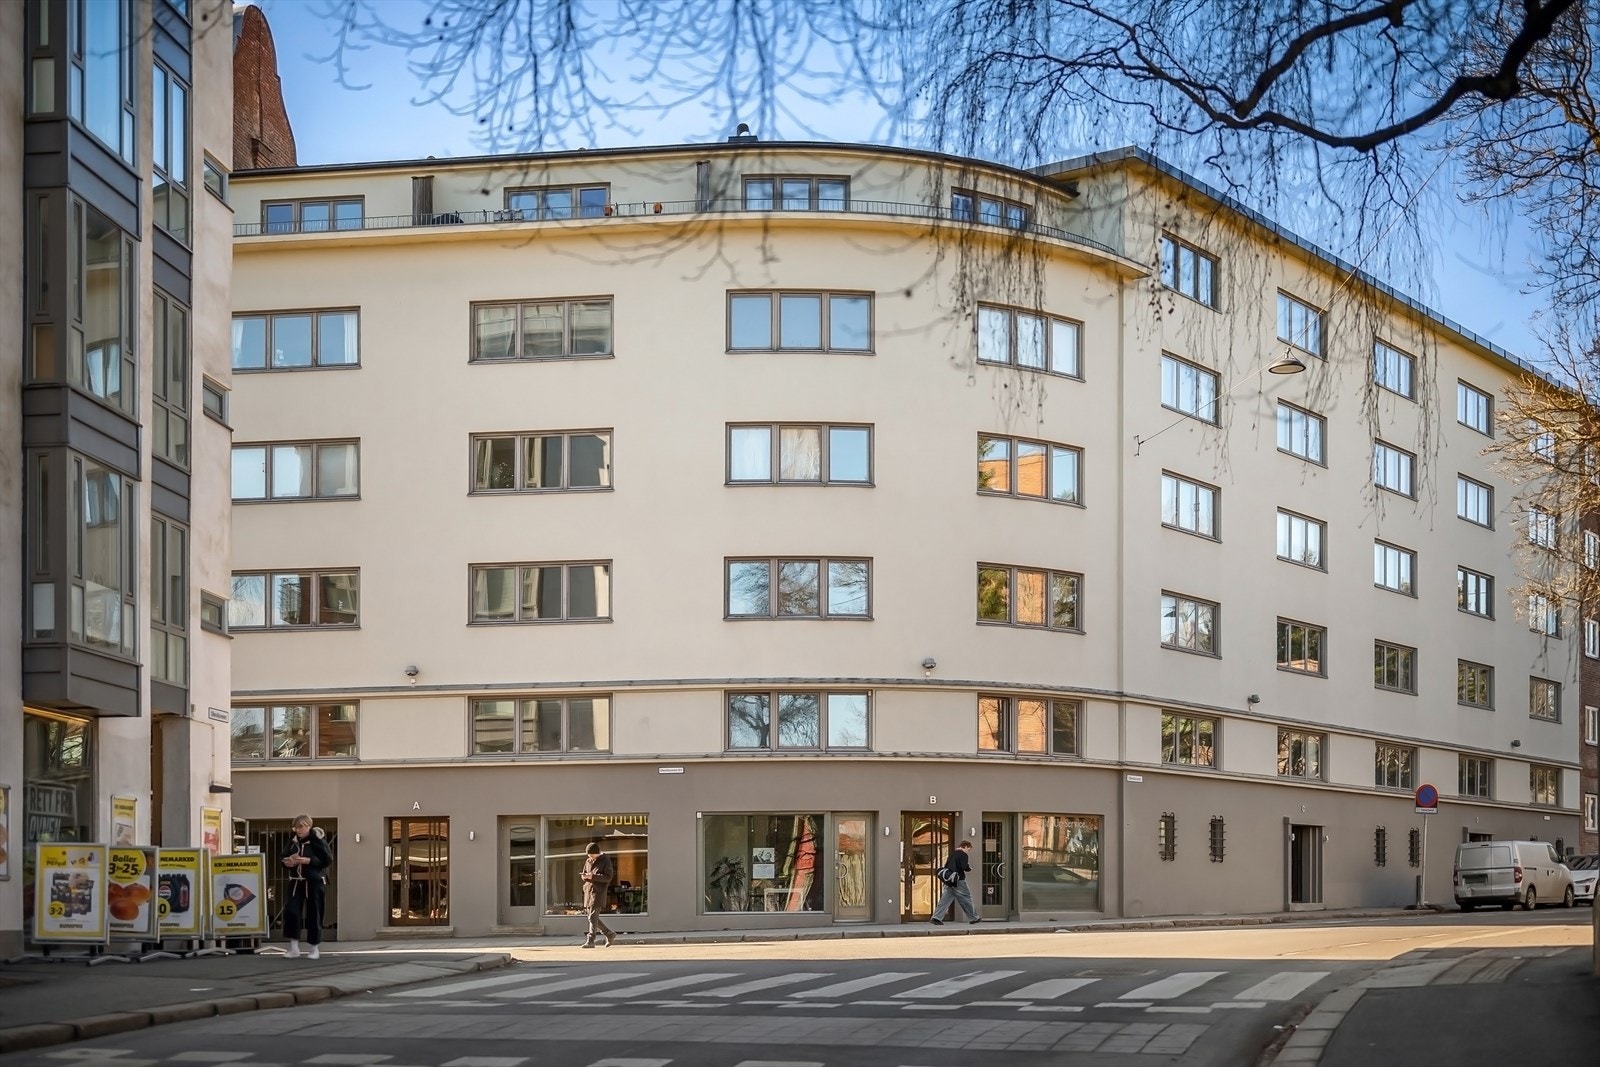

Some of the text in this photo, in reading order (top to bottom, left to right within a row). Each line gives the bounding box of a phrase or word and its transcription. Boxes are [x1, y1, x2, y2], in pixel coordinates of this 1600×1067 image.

[30, 787, 52, 812] RETT
[930, 795, 937, 804] B
[412, 801, 420, 810] A
[112, 854, 138, 863] Boller
[108, 862, 116, 875] 3
[49, 906, 63, 915] 3 2
[219, 905, 234, 915] 15
